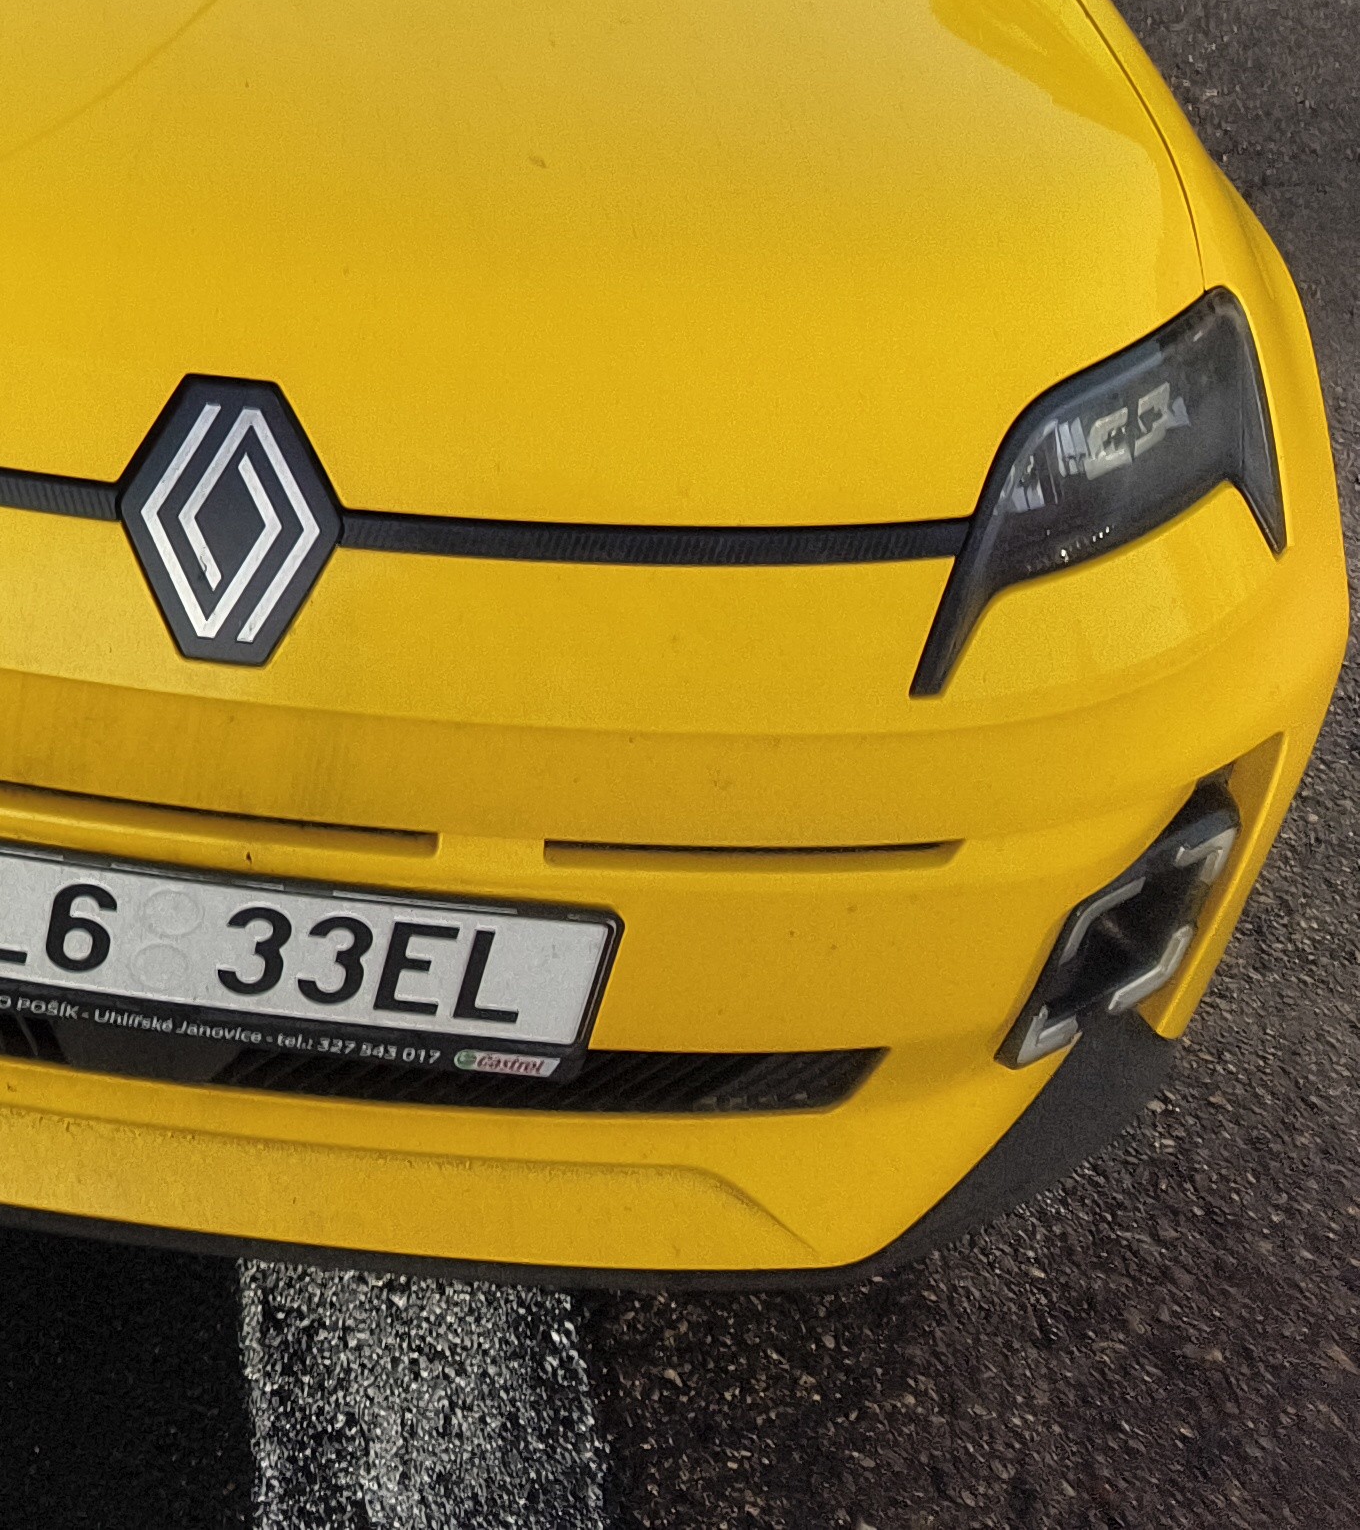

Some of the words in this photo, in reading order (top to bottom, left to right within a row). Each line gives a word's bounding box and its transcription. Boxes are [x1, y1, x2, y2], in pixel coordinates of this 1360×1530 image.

[217, 906, 521, 1025] 33EL
[175, 1020, 262, 1044] Janovice
[401, 1046, 442, 1064] 017
[476, 1054, 546, 1076] Castrol
